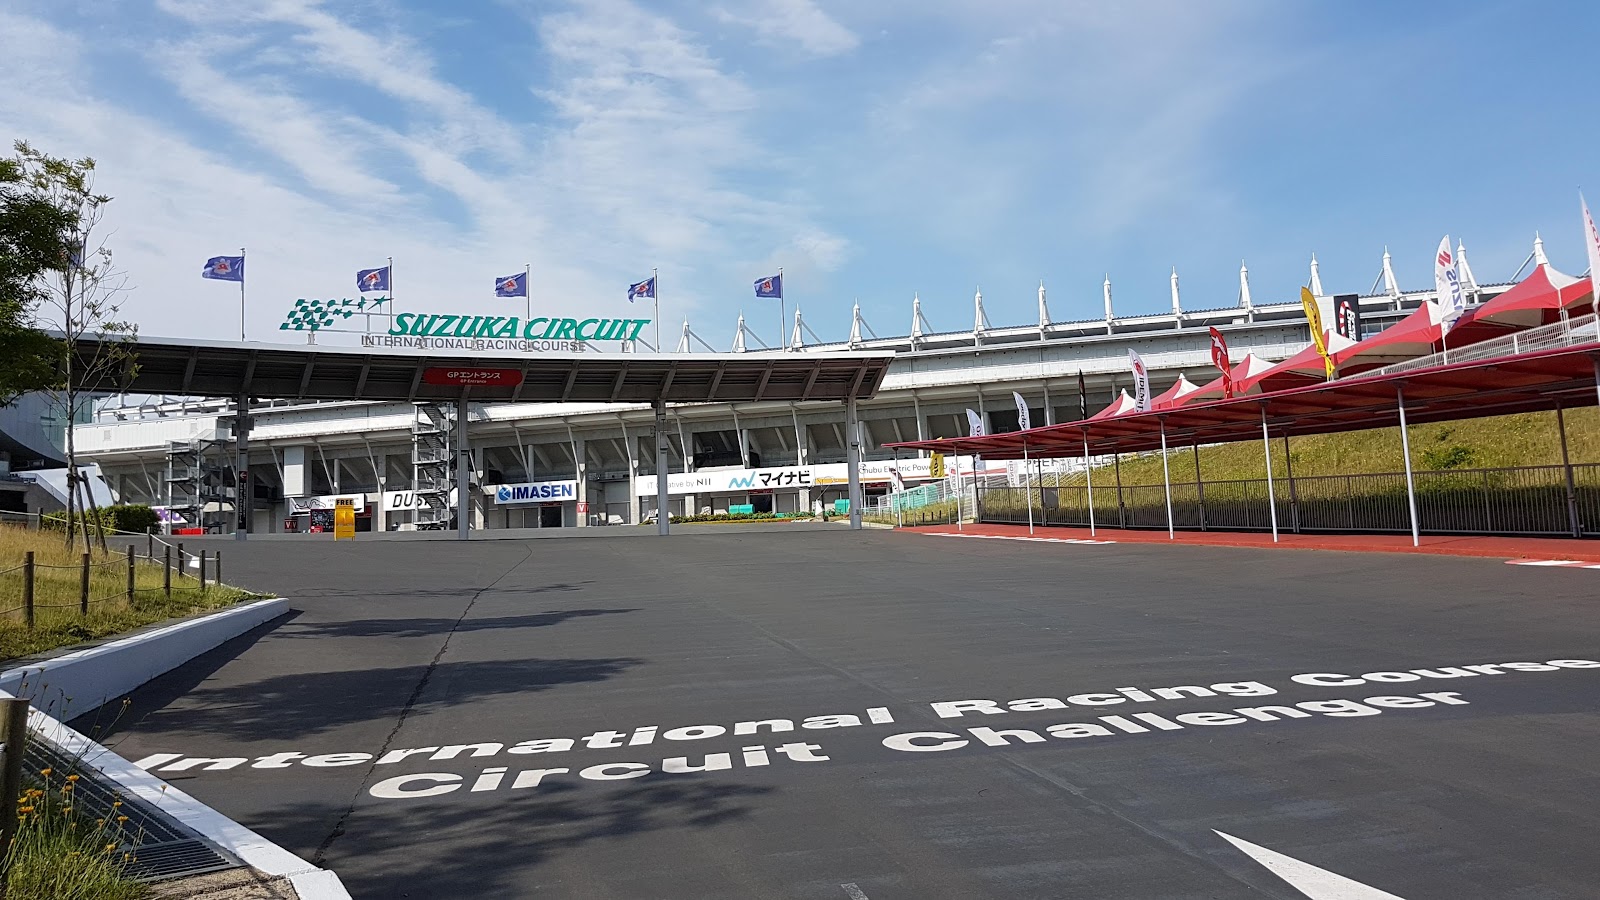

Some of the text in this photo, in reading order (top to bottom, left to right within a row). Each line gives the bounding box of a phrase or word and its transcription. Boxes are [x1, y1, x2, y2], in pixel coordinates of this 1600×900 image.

[388, 312, 652, 341] SUZUKA CIRCUIT
[361, 335, 587, 352] INTERNATIONAL RACING COURSE
[446, 370, 501, 379] GPエントランス
[758, 470, 811, 487] マイナビ
[511, 483, 573, 500] IMASEN
[132, 659, 1600, 771] International Racing Course
[369, 692, 1470, 798] Circuit Challenger
